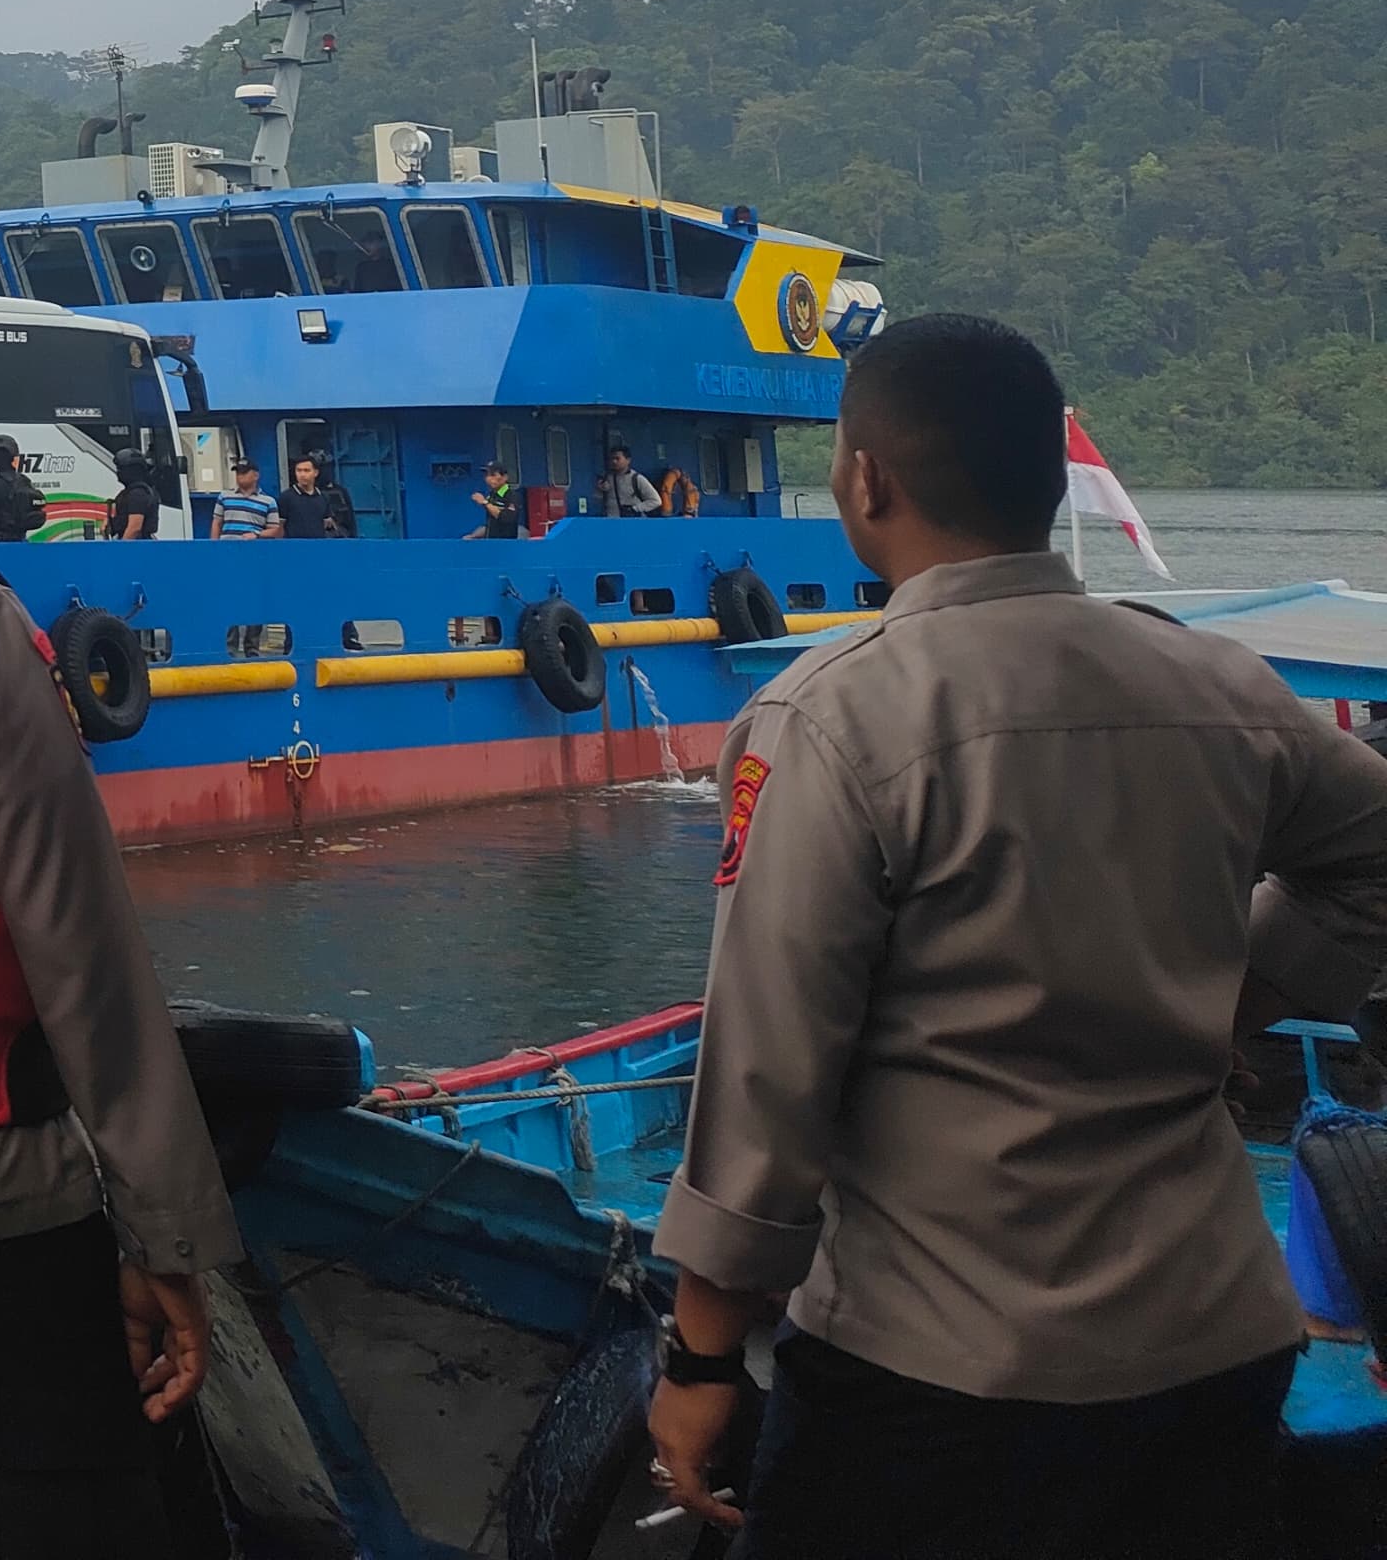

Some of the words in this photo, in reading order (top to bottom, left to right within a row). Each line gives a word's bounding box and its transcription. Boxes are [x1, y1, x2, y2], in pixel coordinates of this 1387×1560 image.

[6, 331, 28, 343] BUS
[43, 452, 76, 474] Trans
[293, 693, 300, 707] 6
[293, 720, 300, 734] 4
